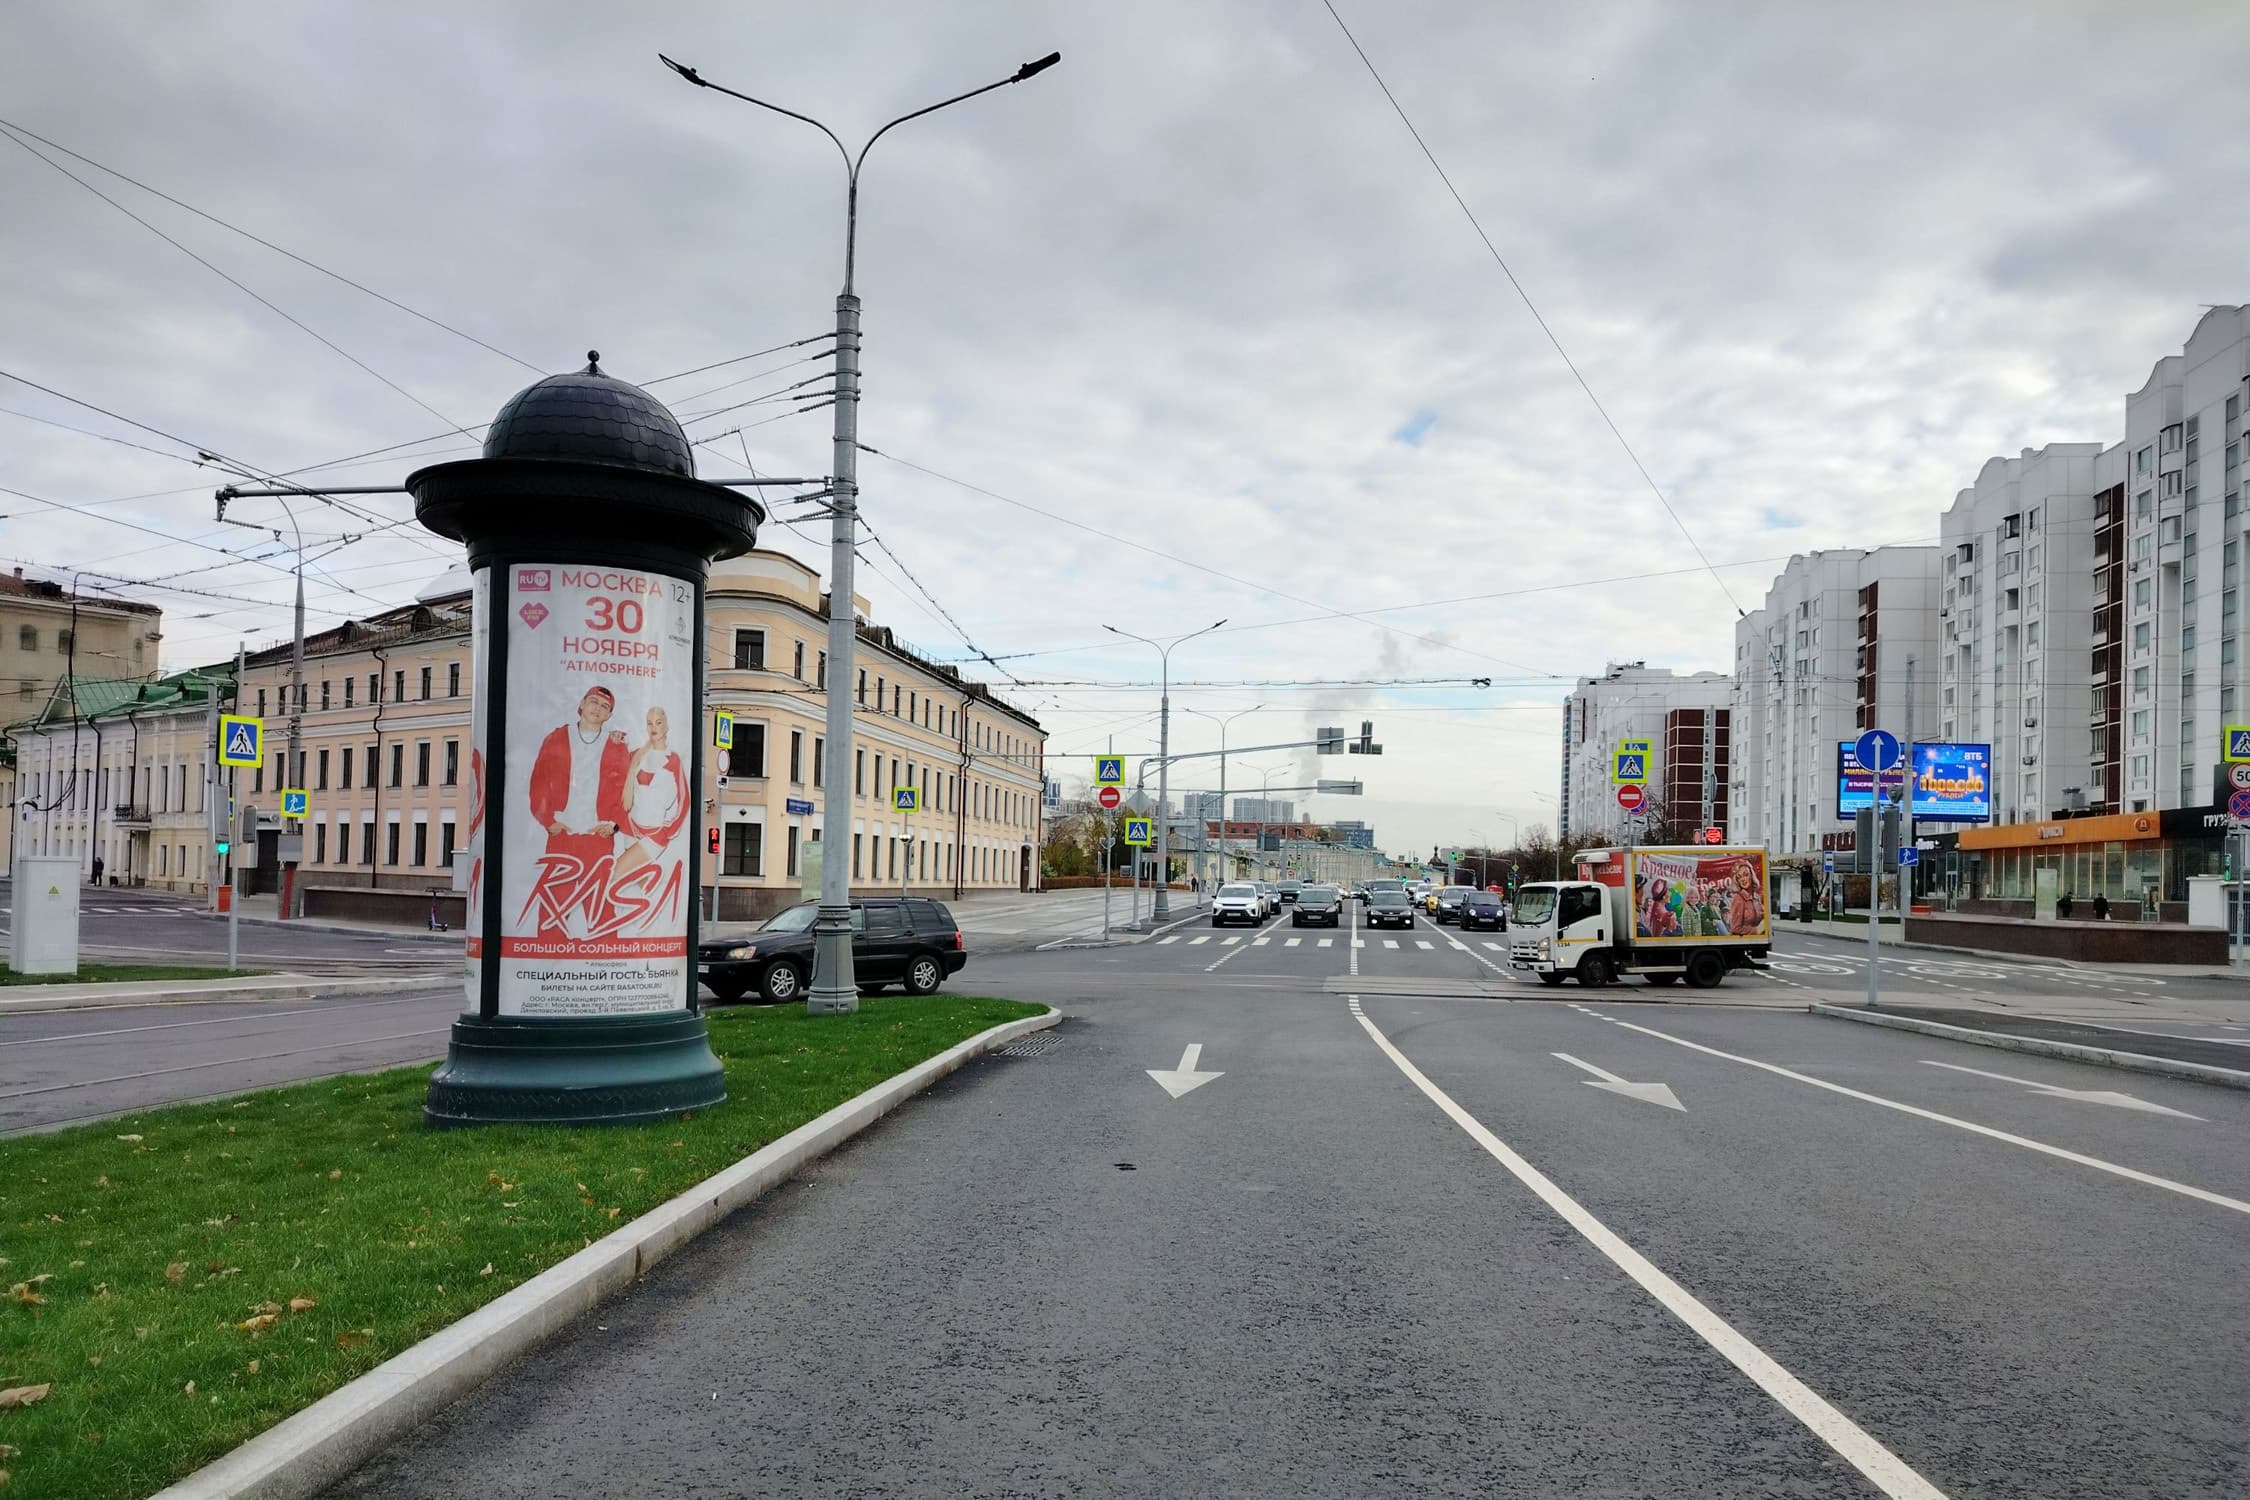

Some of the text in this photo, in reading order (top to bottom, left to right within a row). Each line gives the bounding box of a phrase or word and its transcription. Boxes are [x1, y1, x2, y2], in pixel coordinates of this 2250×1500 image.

[561, 570, 662, 598] МОСКВА
[671, 583, 692, 604] 12+
[584, 595, 643, 634] 30
[563, 636, 659, 661] НОЯБРЯ
[1964, 752, 1983, 760] ВТБ
[2237, 771, 2250, 782] 50
[1640, 855, 1692, 880] Красное
[513, 942, 682, 953] БОЛЬШОЙ СОЛЬНЫЙ КОНЦЕРТ
[516, 969, 679, 981] СПЕЦИАЛЬНЫЙ ГОСТЬ: БЬЯНКА
